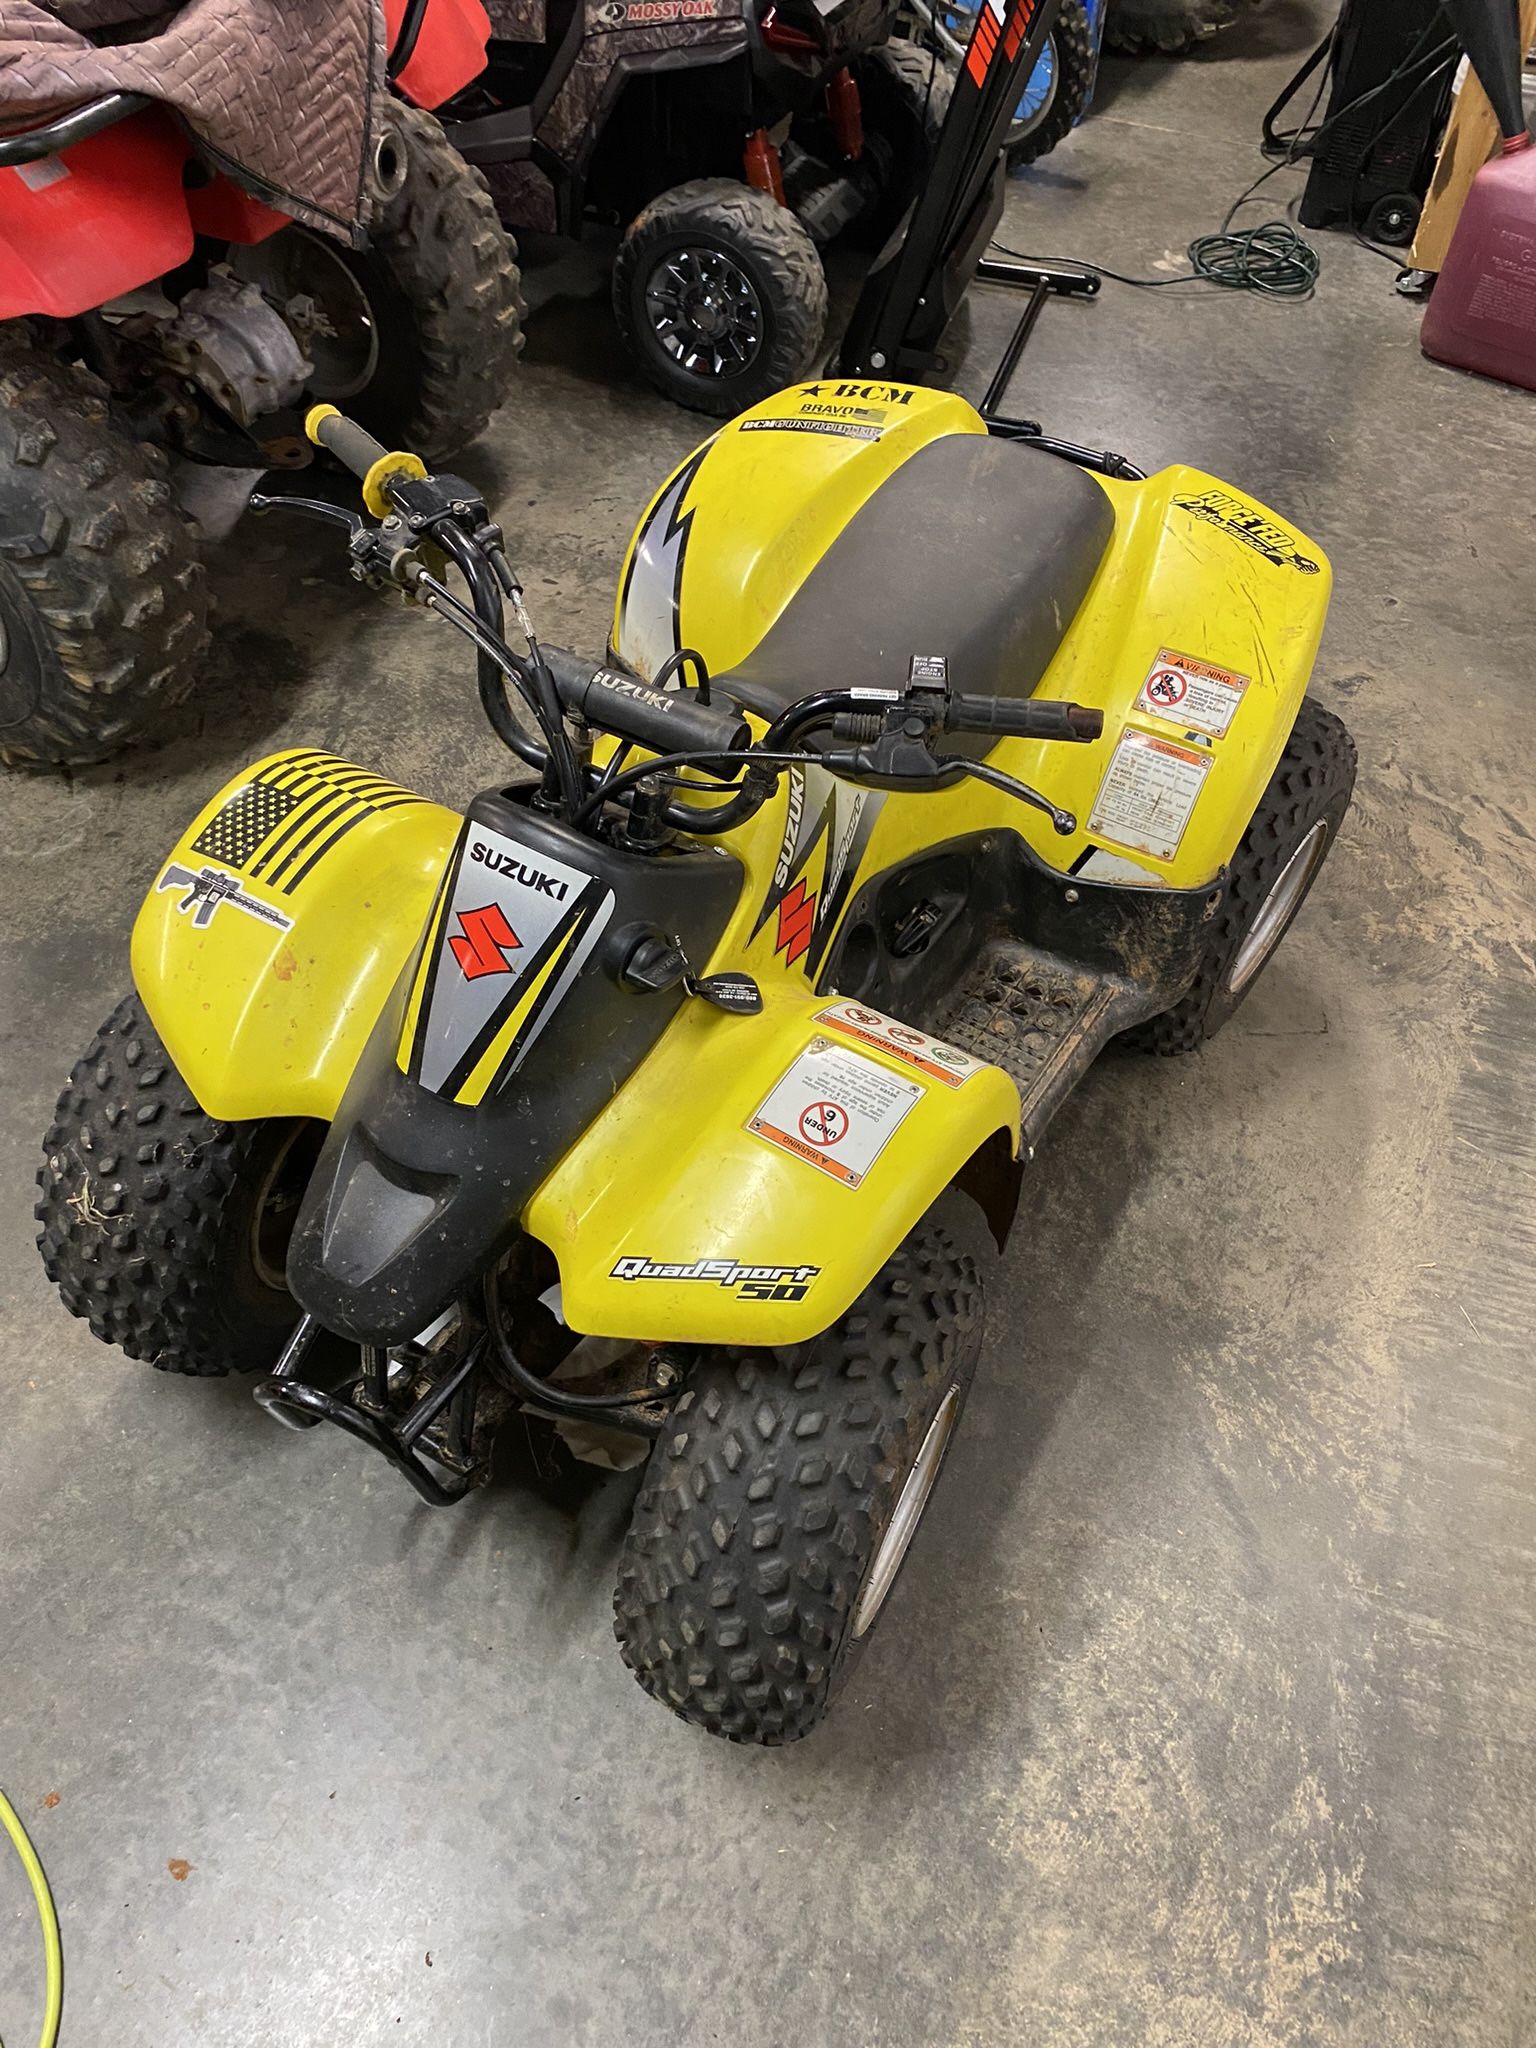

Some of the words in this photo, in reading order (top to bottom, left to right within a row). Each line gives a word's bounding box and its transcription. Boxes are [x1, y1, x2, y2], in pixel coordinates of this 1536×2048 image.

[627, 2, 680, 20] MOSSY
[681, 0, 716, 17] OAK
[834, 384, 916, 405] BCM
[801, 403, 854, 415] BRAVO
[1170, 493, 1269, 555] Performance
[1200, 490, 1264, 527] FORCE
[1248, 522, 1295, 549] FED
[1186, 661, 1231, 685] WNING
[592, 671, 675, 712] SUZUKI
[1154, 742, 1185, 759] WARNING
[774, 766, 805, 888] SUZUKI
[470, 842, 569, 901] SUZUKI
[856, 1030, 909, 1057] WARNING
[804, 1117, 837, 1138] UNDER
[825, 1110, 836, 1122] 6
[783, 1136, 819, 1160] WARNING
[609, 1256, 822, 1286] QuadSport
[736, 1283, 810, 1300] 50
